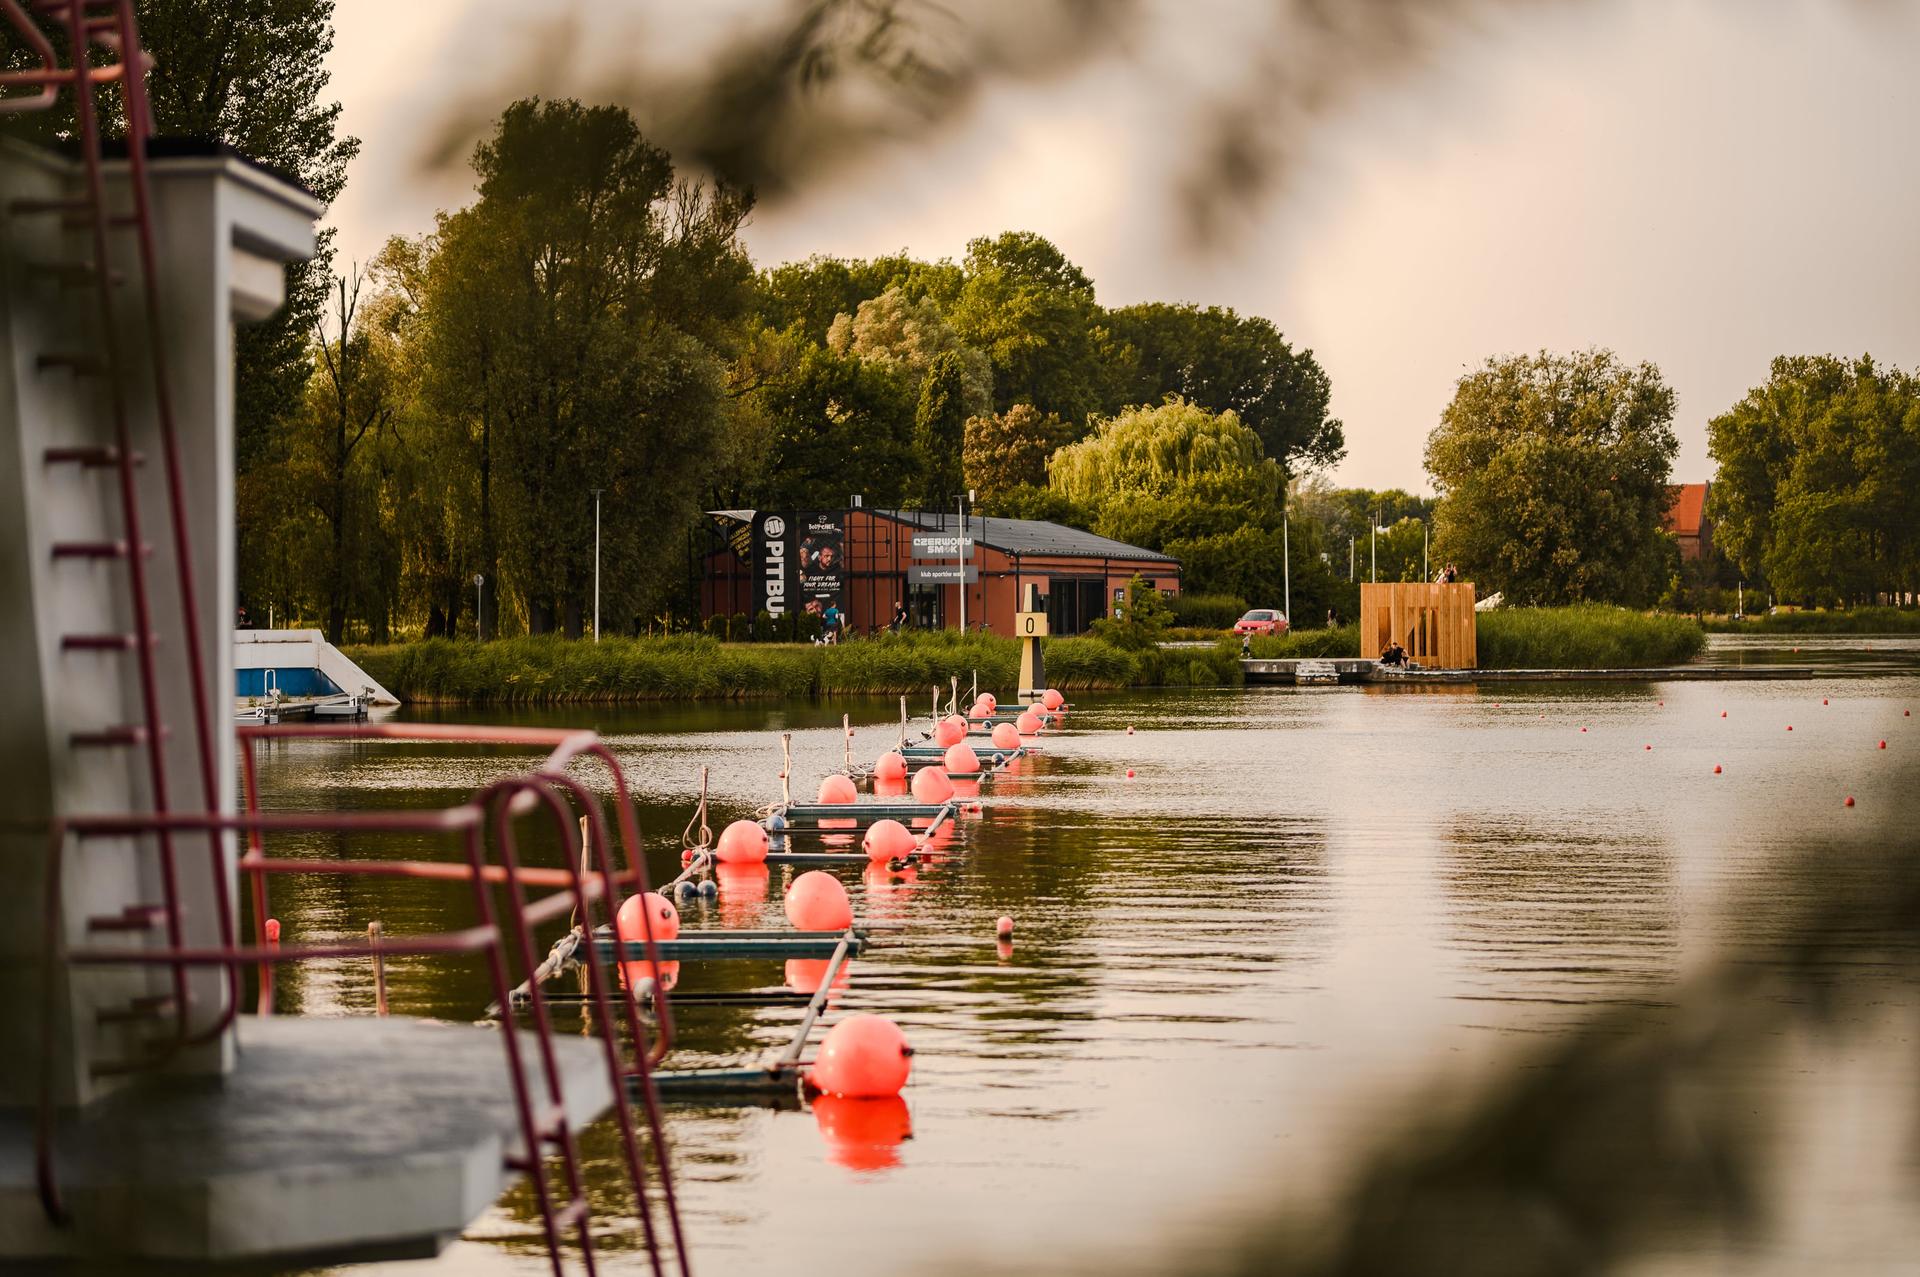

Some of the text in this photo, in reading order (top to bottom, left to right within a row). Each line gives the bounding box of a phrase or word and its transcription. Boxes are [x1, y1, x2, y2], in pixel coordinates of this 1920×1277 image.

[914, 538, 972, 546] CZERWONY
[1026, 617, 1034, 634] 0
[257, 708, 264, 718] 2
